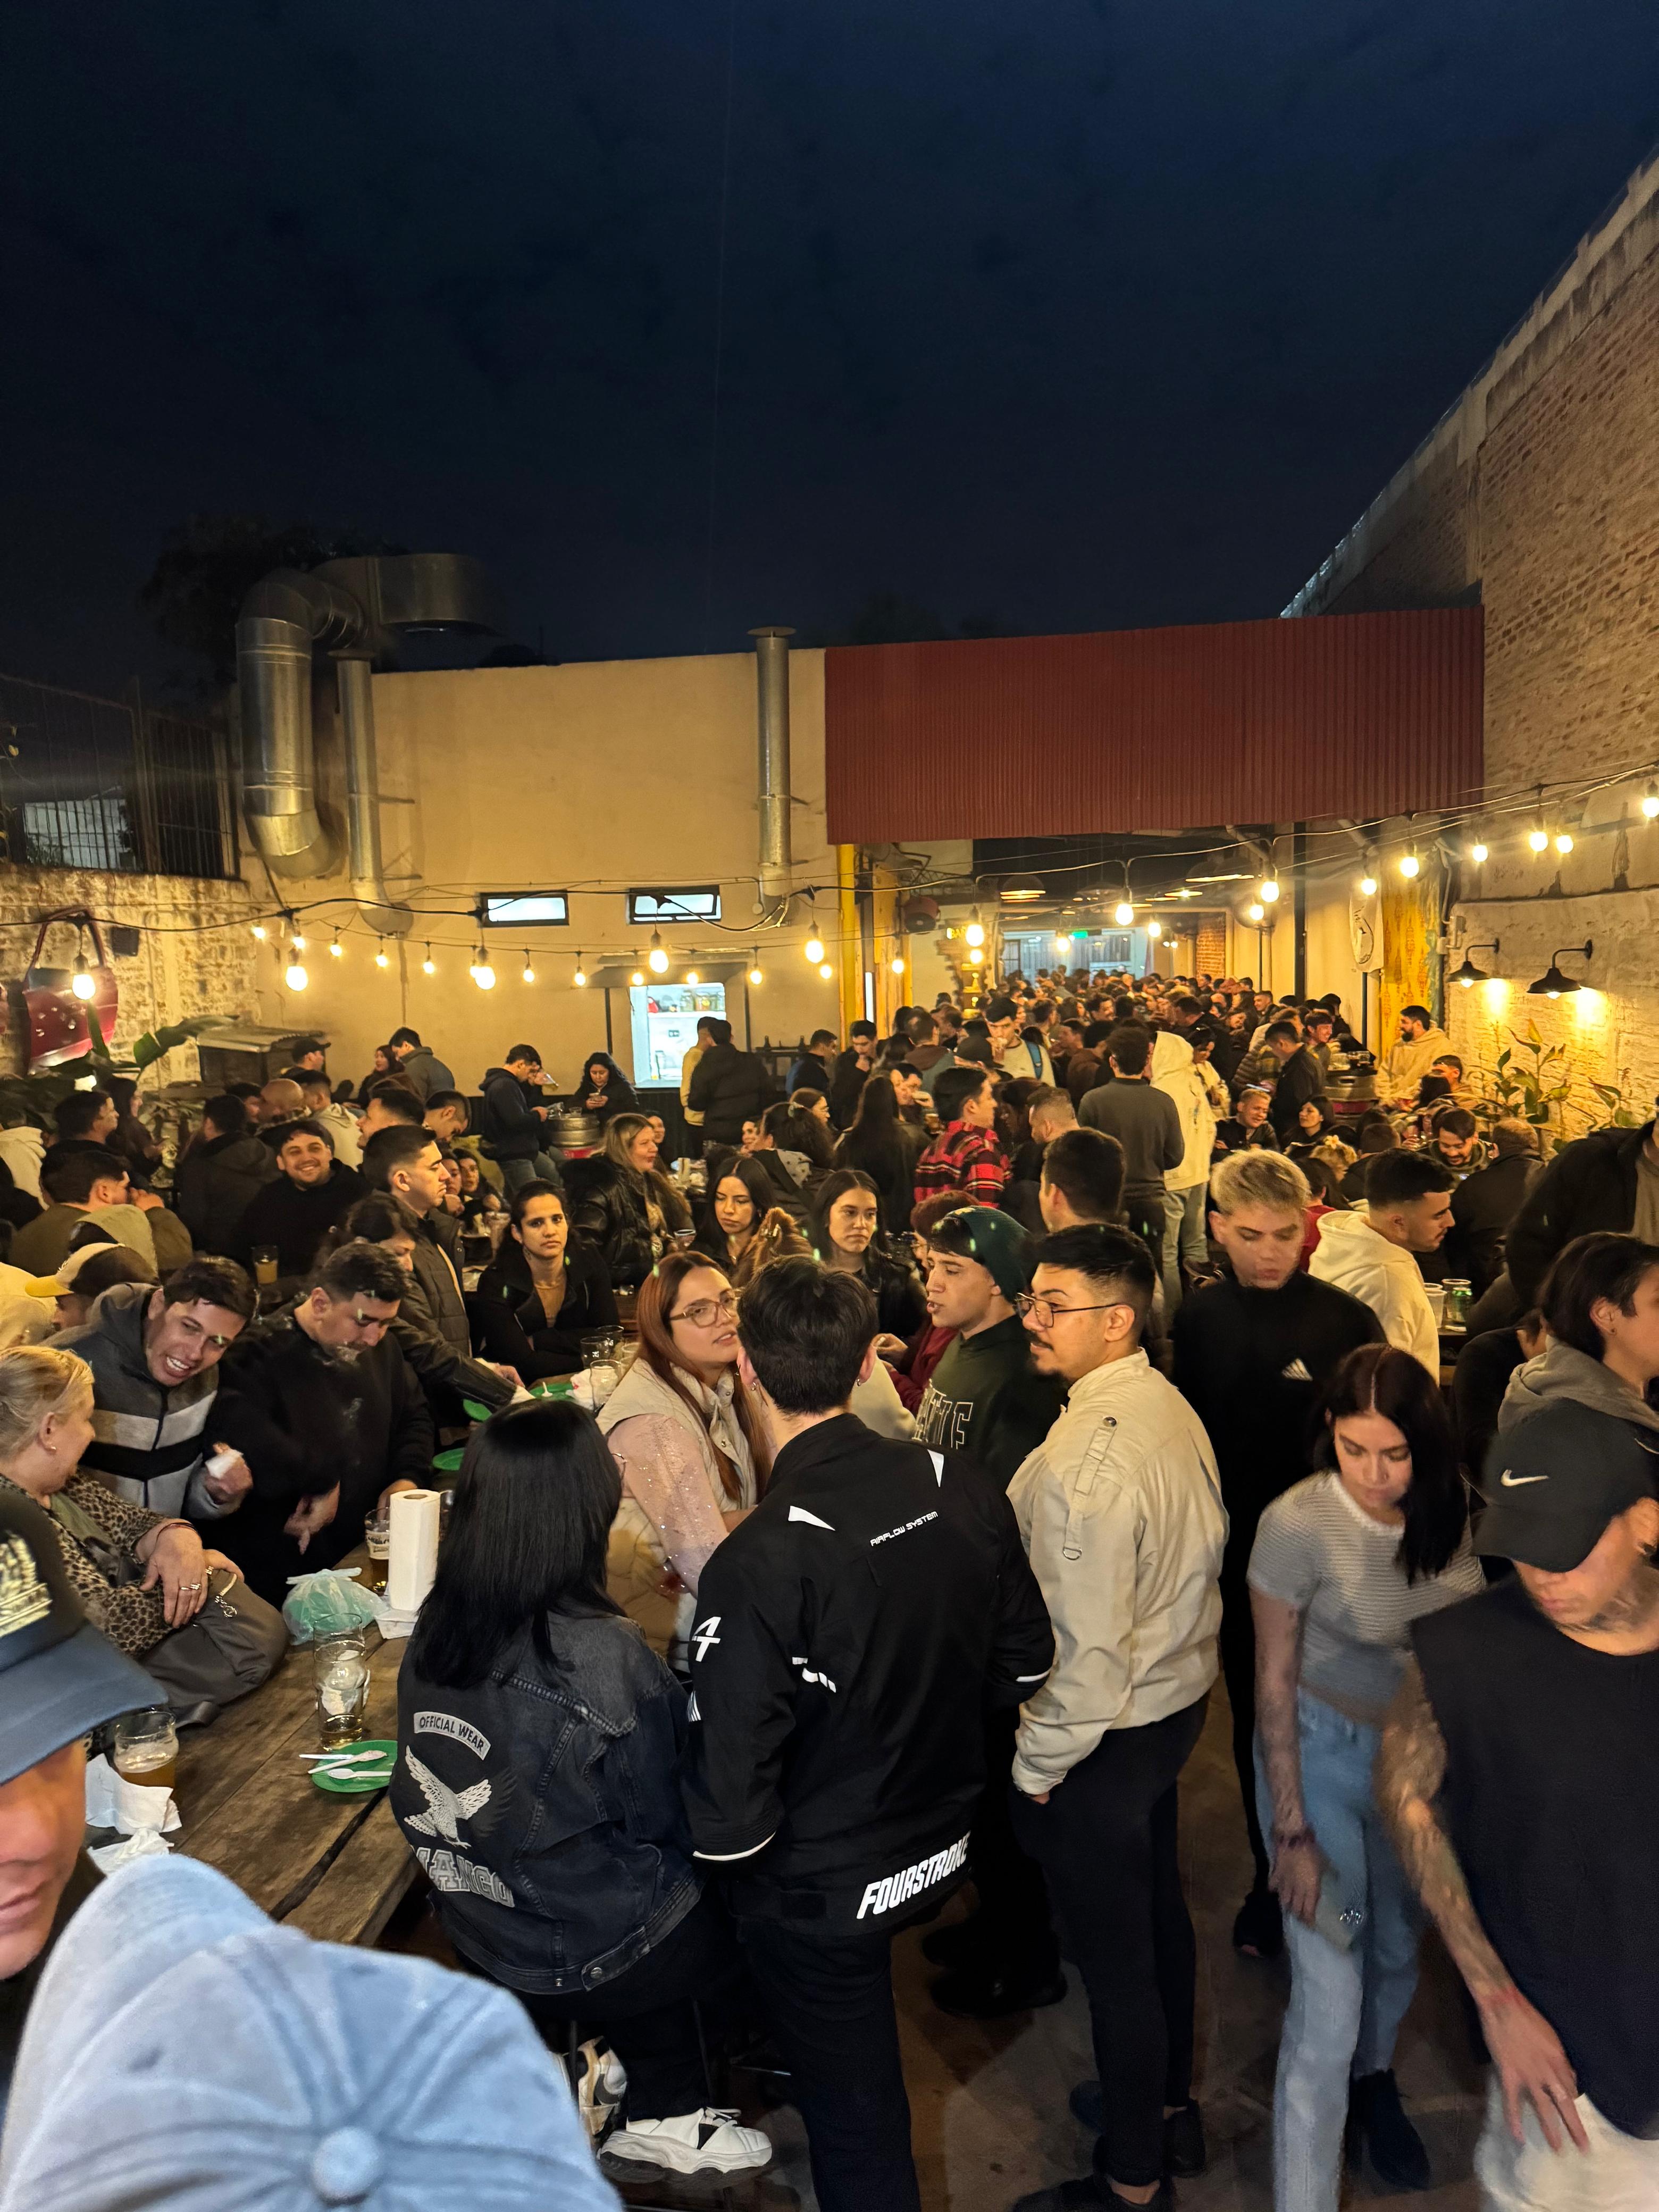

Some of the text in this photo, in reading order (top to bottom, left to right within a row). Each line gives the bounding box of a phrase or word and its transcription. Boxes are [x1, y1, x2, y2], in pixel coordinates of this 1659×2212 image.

[870, 1511, 939, 1546] AIRFLOW SYSTEM
[420, 1715, 484, 1752] OFFICIAL WEAR
